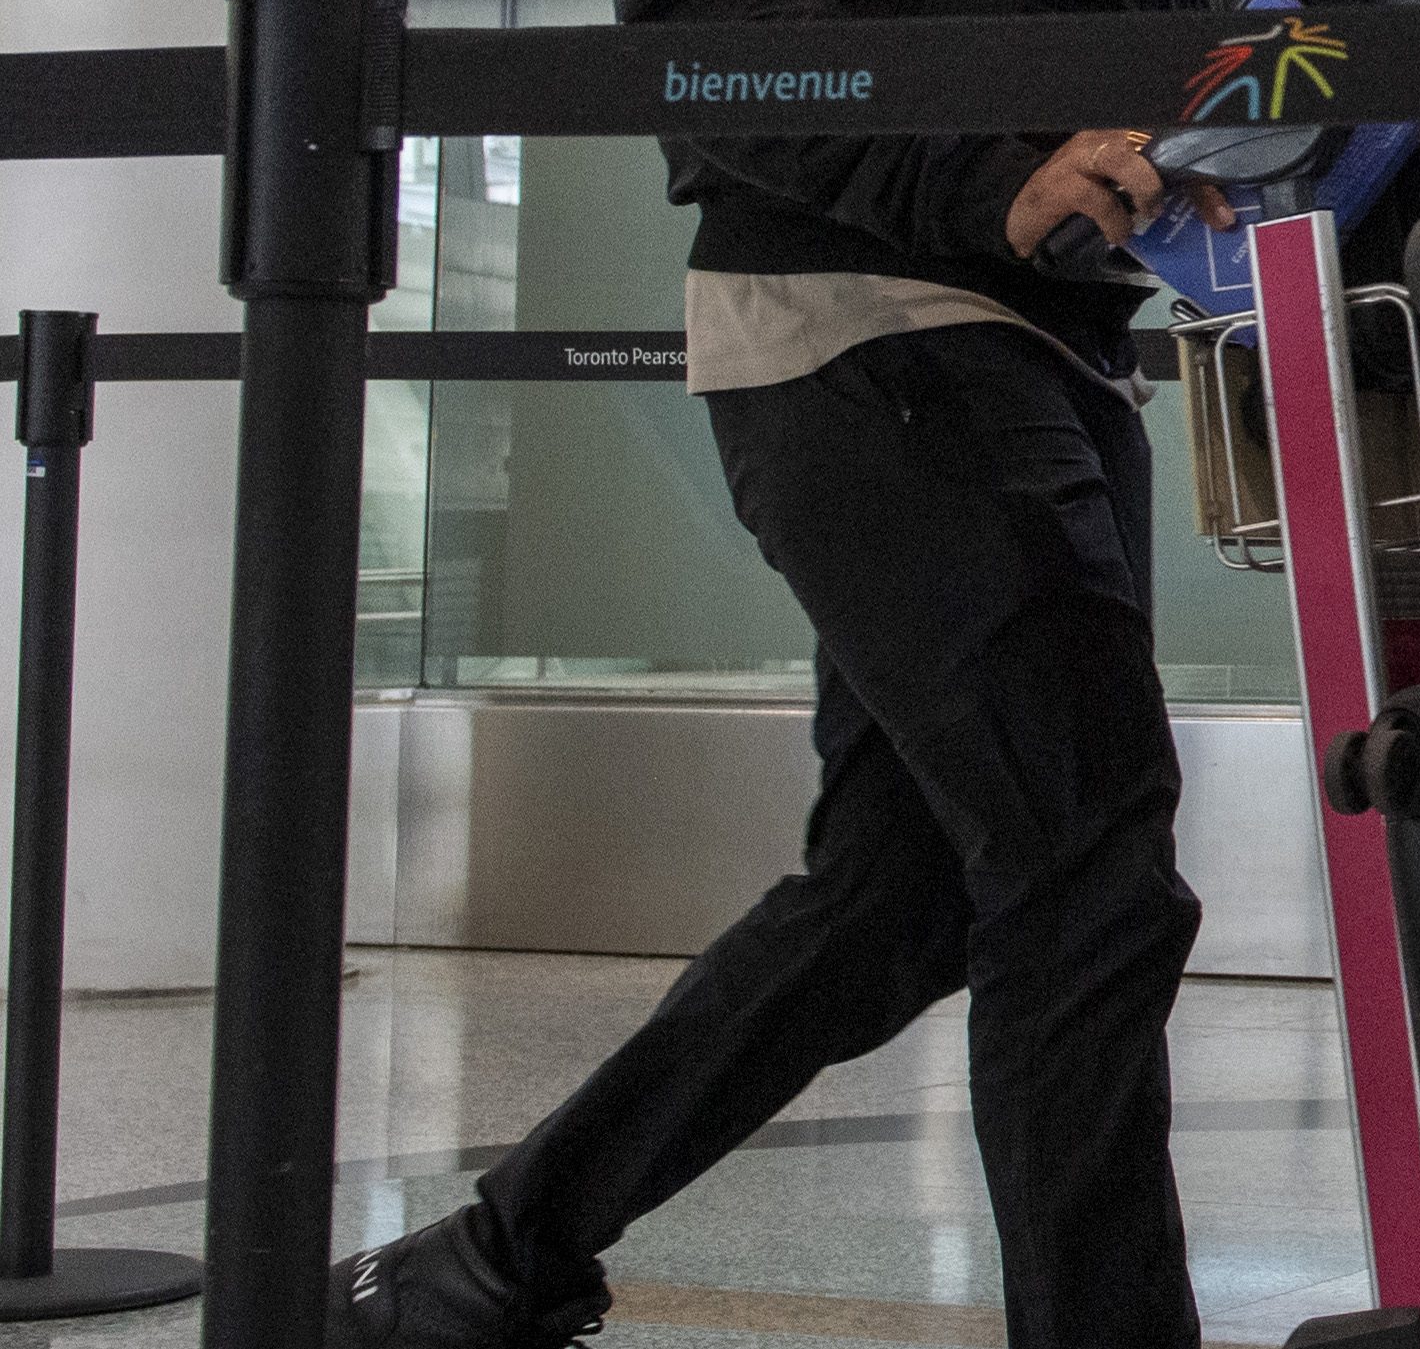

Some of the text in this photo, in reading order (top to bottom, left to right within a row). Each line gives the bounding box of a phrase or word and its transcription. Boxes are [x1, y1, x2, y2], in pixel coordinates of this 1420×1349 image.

[665, 61, 872, 101] bienvenue
[565, 348, 686, 365] Toronto Pearso
